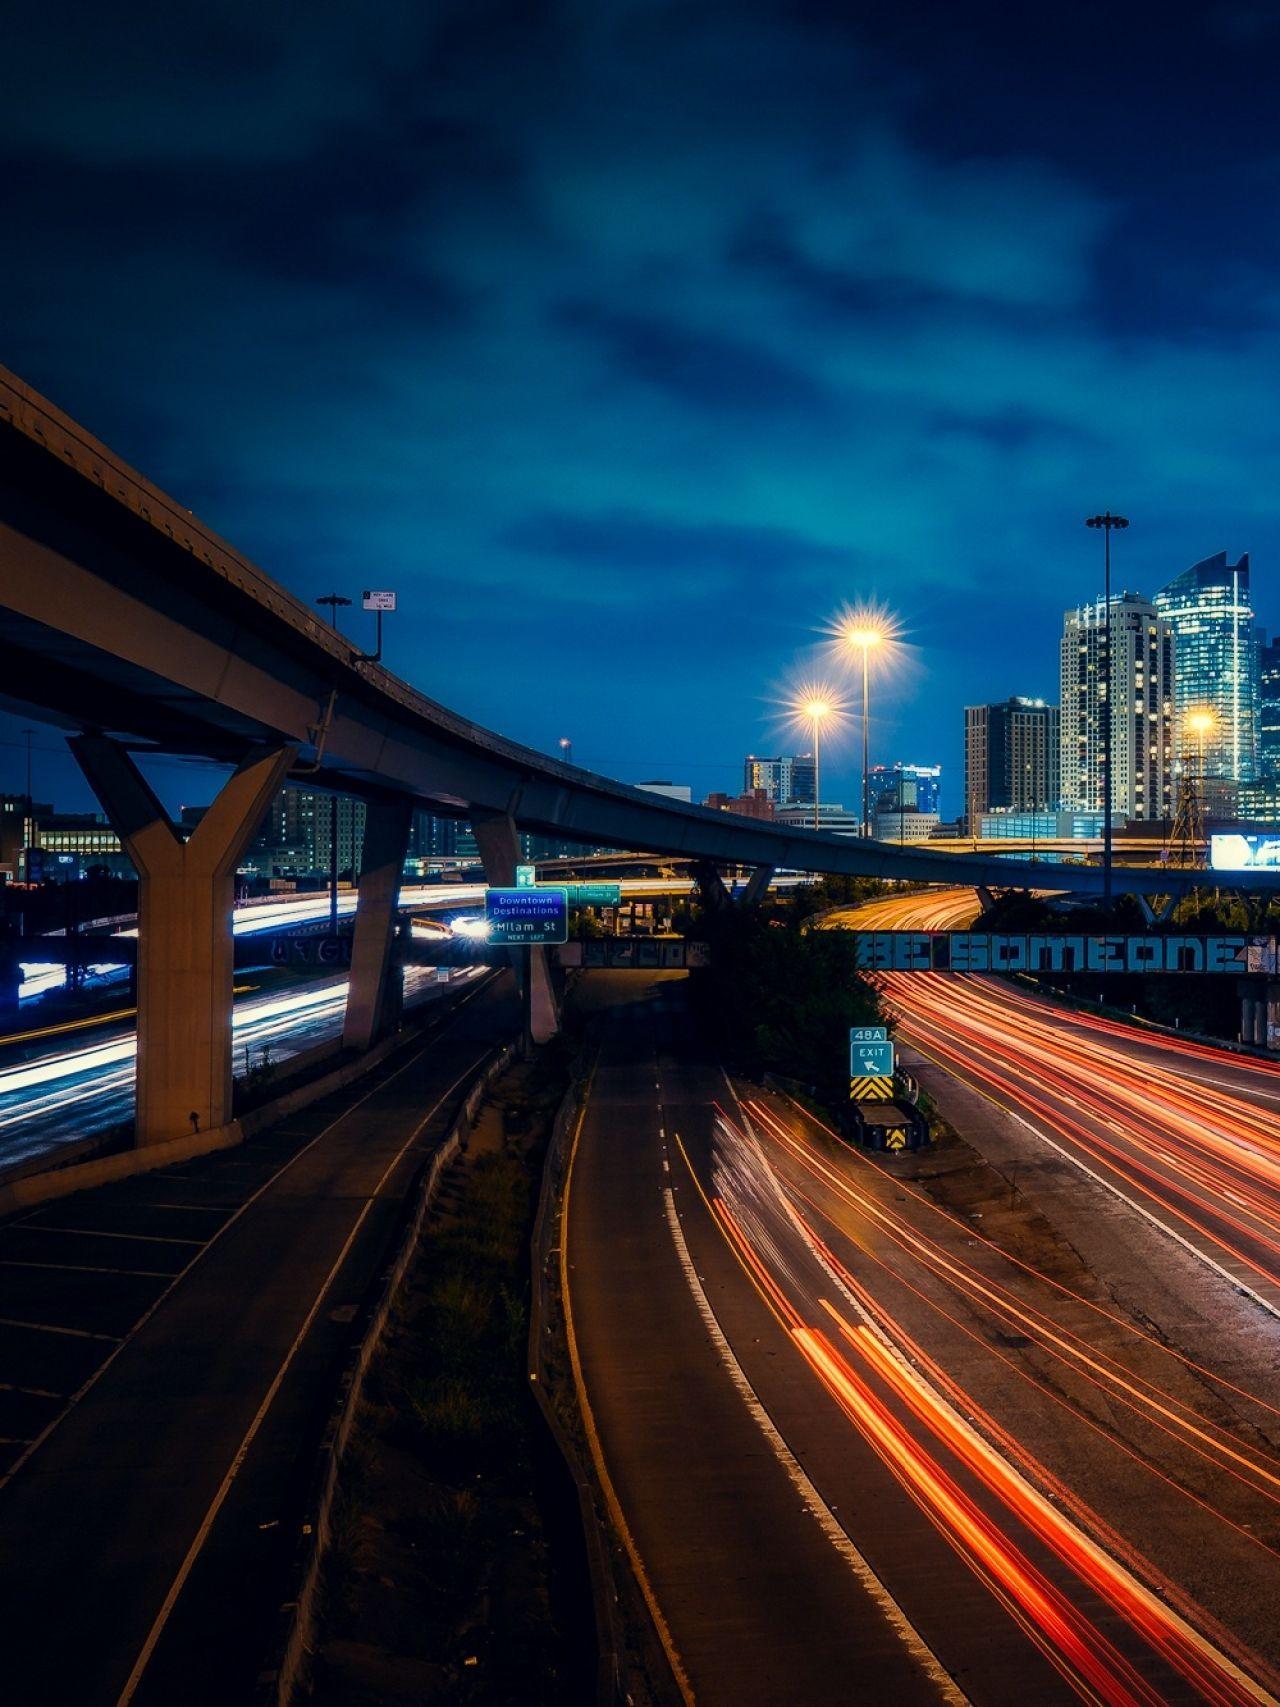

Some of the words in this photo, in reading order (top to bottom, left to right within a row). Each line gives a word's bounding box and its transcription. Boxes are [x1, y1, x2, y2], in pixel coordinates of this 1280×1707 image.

[499, 897, 553, 905] Downtown
[493, 906, 559, 915] Destinations
[496, 922, 534, 932] Milam
[543, 922, 556, 932] St
[856, 934, 931, 970] BE
[950, 934, 1246, 972] SOMEONE
[854, 1030, 882, 1041] 48A
[859, 1048, 885, 1057] EXIT
